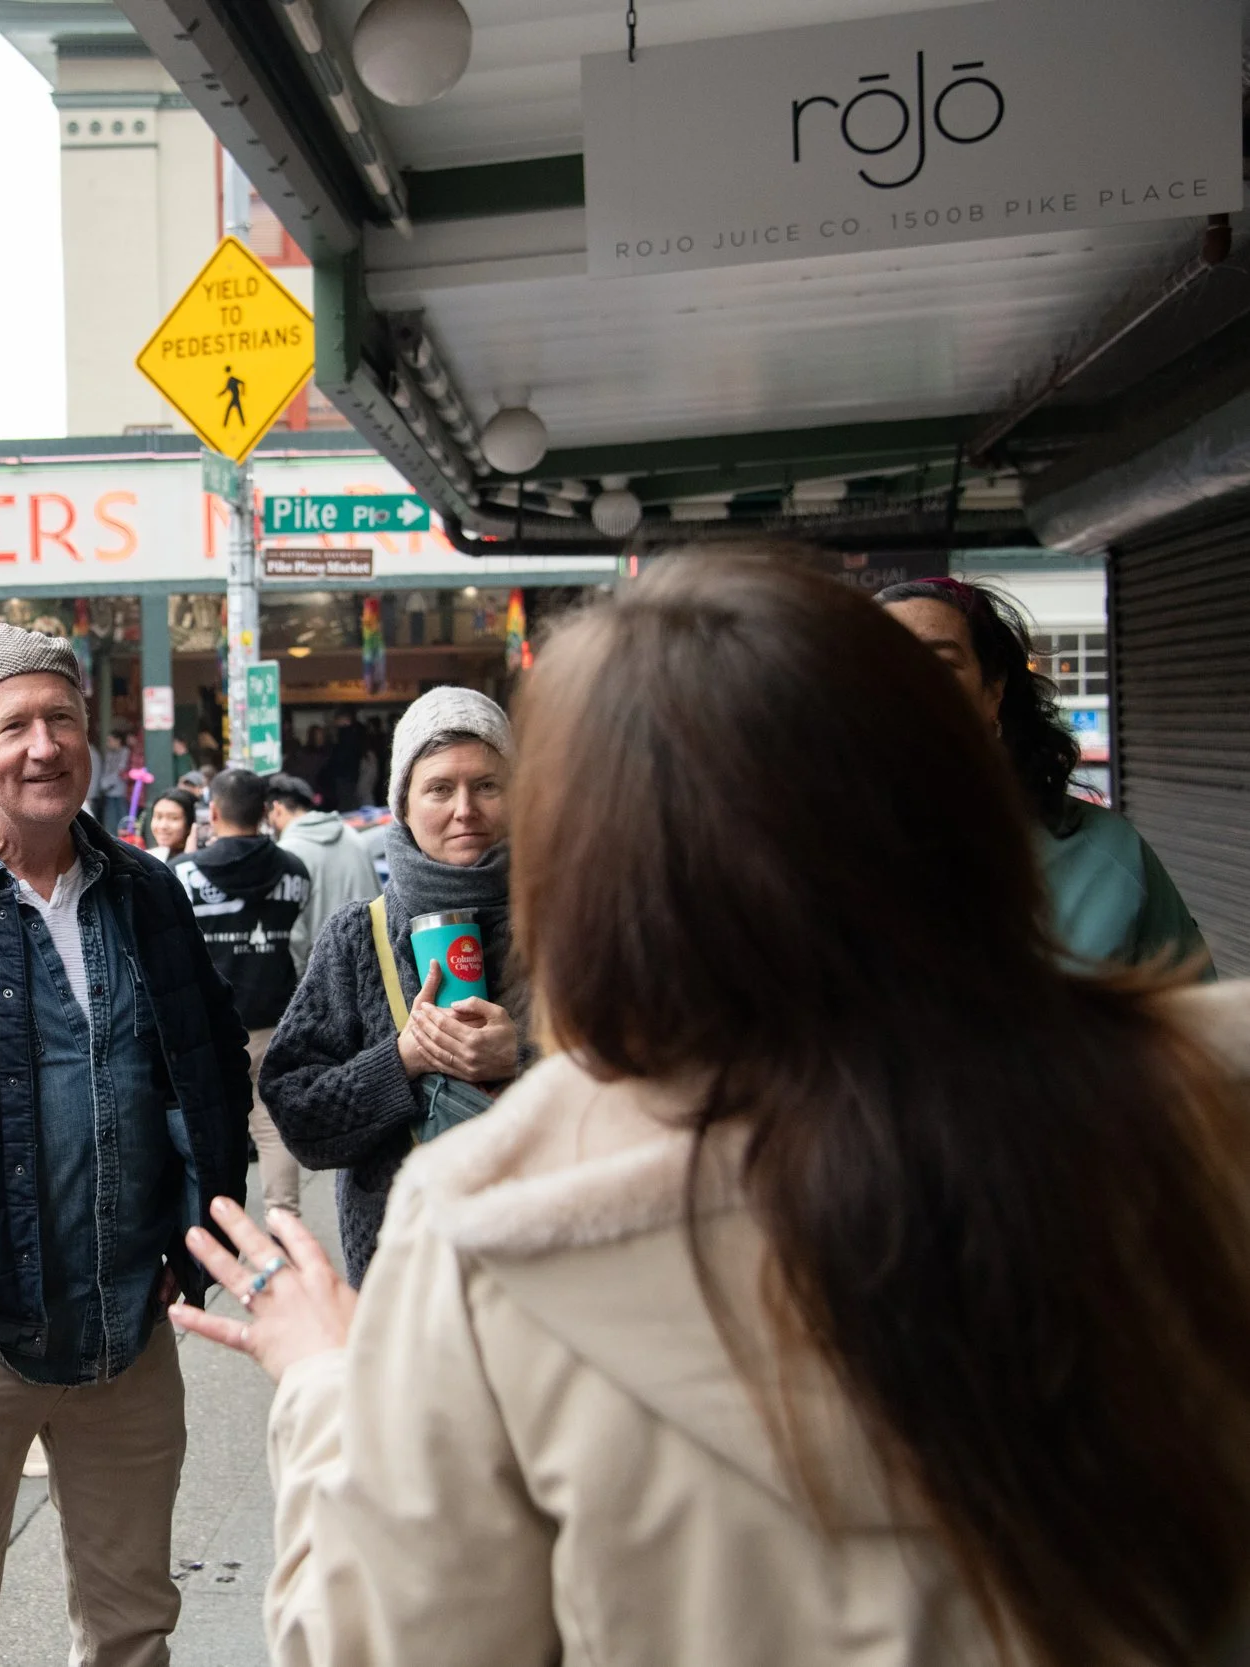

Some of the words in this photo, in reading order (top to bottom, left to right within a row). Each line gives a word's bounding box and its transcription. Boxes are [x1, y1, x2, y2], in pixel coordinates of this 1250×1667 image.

[615, 235, 694, 259] ROJO
[713, 224, 801, 250] JUICE
[819, 217, 871, 239] CO.
[890, 203, 985, 230] 1500B
[1005, 193, 1078, 218] PIKE
[1100, 178, 1208, 207] PLACE
[202, 276, 260, 302] YIELD
[220, 305, 243, 326] TO
[161, 325, 302, 360] PEDESTRIANS
[272, 498, 338, 530] Pike
